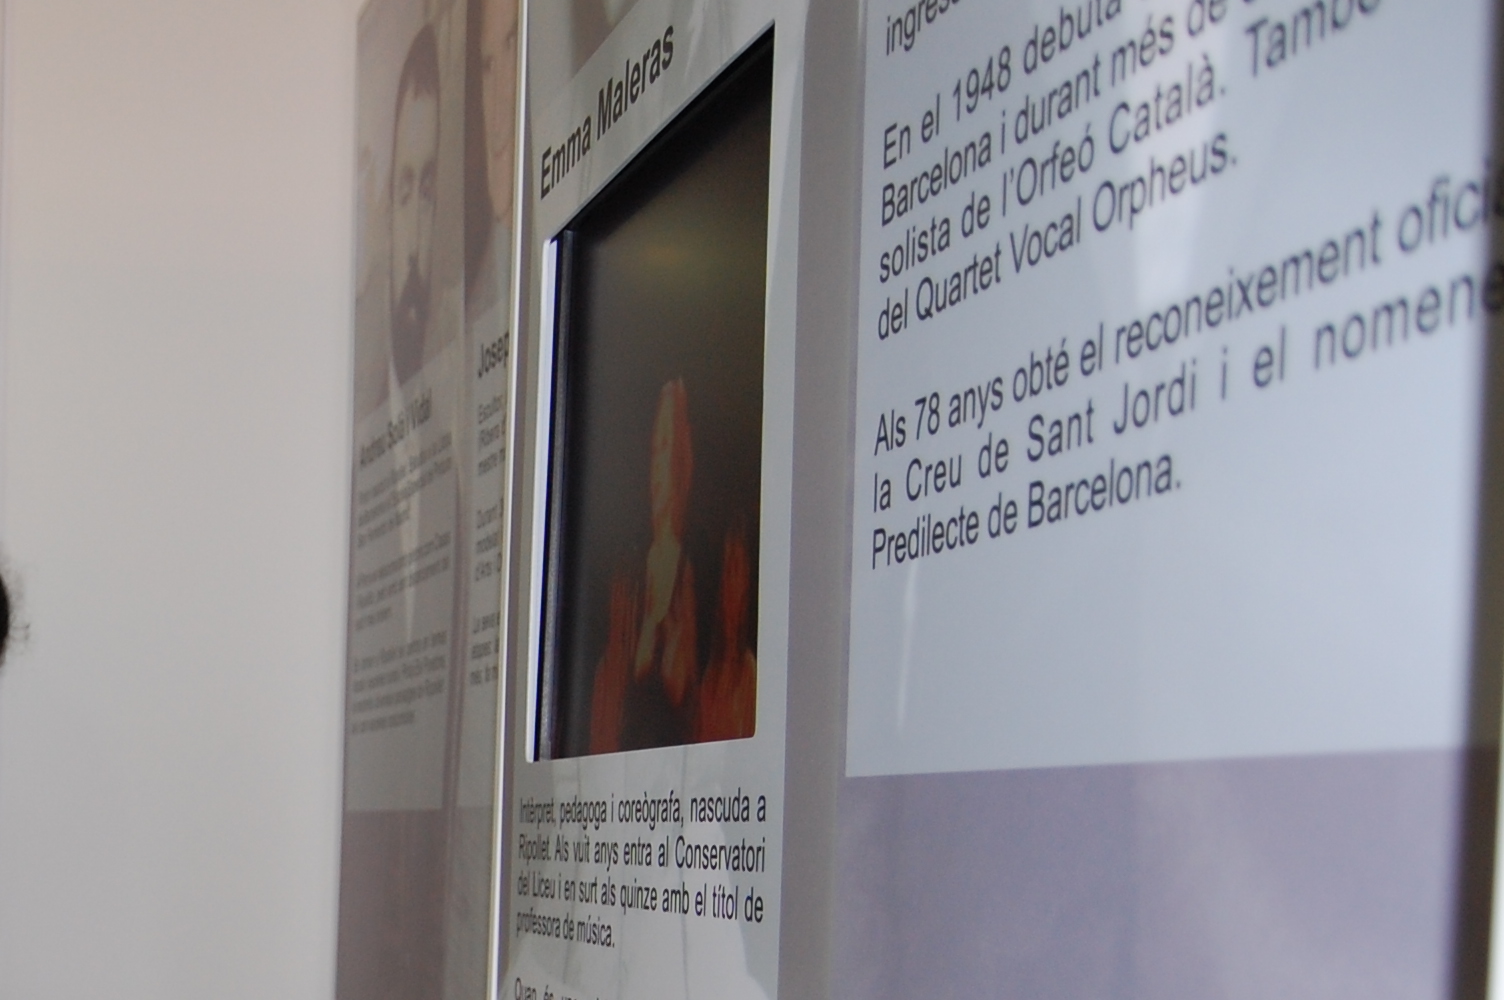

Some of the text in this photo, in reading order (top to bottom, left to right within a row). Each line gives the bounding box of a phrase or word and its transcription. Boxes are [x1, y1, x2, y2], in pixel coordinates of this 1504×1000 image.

[540, 25, 674, 200] Emma Maleras
[879, 216, 951, 284] solista
[961, 192, 991, 238] de
[1108, 53, 1226, 155] Català.
[881, 131, 992, 227] Barcelona
[999, 110, 1006, 154] i
[1014, 53, 1101, 144] durant
[1111, 13, 1175, 88] més
[883, 124, 911, 169] En
[921, 93, 940, 142] el
[953, 46, 1011, 121] 1948
[878, 132, 1236, 340] del Quartet Vocal Orpheus.
[874, 408, 907, 456] Als
[914, 391, 941, 441] 78
[947, 375, 1003, 429] anys
[1012, 337, 1070, 402] obté
[1080, 322, 1103, 376] el
[1114, 209, 1382, 364] reconeixement
[873, 472, 891, 513] la
[906, 453, 962, 501] Creu
[978, 432, 1009, 478] de
[1027, 398, 1095, 462] Sant
[1113, 357, 1197, 435] Jordi
[1221, 346, 1228, 399] i
[1253, 325, 1286, 389] el
[872, 453, 1182, 570] Predilecte de Barcelona.
[555, 834, 569, 862] Als
[573, 834, 590, 863] vuit
[594, 841, 619, 872] anys
[623, 836, 652, 867] entra
[658, 835, 669, 867] al
[675, 835, 765, 873] Conservatori
[560, 795, 607, 830] pedagoga
[611, 793, 615, 822] i
[618, 789, 684, 831] coreògrafa,
[690, 787, 750, 822] nascuda
[756, 795, 766, 822] a
[517, 870, 530, 896] del
[532, 871, 556, 899] Liceu
[564, 880, 576, 902] en
[579, 877, 598, 905] surt
[601, 876, 616, 907] als
[620, 878, 657, 915] quinze
[662, 882, 690, 915] amb
[695, 883, 707, 917] el
[712, 884, 738, 920] títol
[744, 886, 764, 923] de
[563, 912, 574, 941] de
[577, 914, 615, 948] música.
